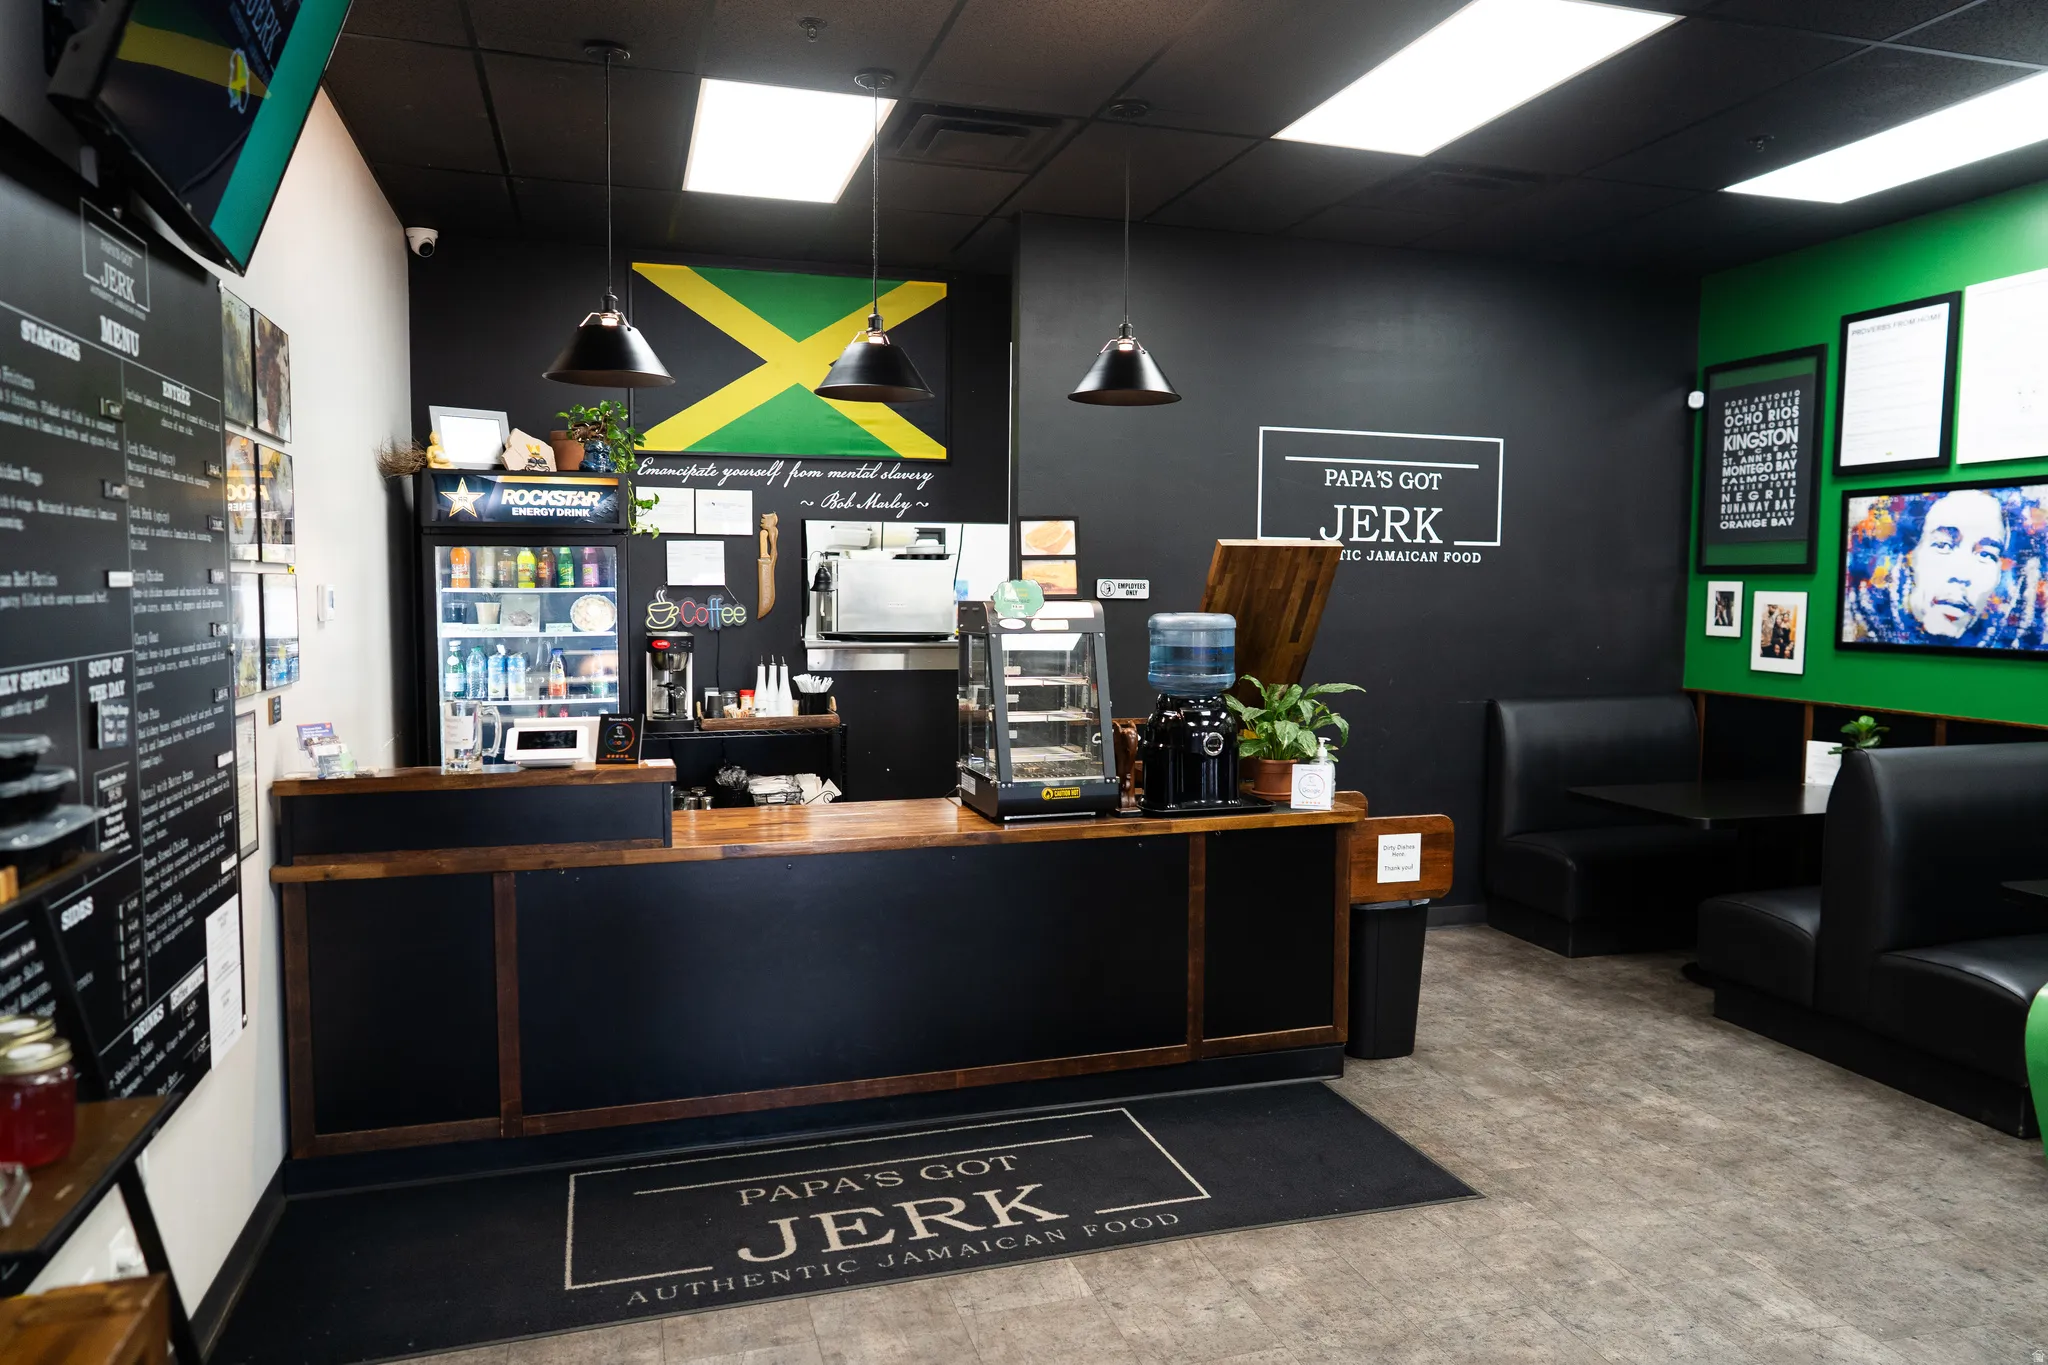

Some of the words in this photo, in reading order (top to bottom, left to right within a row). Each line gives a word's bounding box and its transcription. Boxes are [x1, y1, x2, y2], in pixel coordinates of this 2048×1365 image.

[100, 262, 136, 304] JERK
[100, 315, 140, 358] MENU
[1851, 323, 1891, 336] PROVERBS
[1893, 317, 1916, 328] FROM
[20, 319, 81, 362] STARTERS
[1724, 398, 1748, 408] PORT
[1754, 389, 1800, 404] ANTONIO
[1724, 397, 1800, 416] MANDEVILLE
[1724, 411, 1763, 428] OCHO
[1767, 405, 1800, 422] RIOS
[1724, 417, 1799, 435] WHITEHOUSE
[1723, 426, 1799, 452] KINGSTON
[1722, 457, 1736, 467] ST.
[1740, 453, 1772, 465] ANN'S
[1776, 450, 1798, 461] BAY
[1722, 461, 1773, 477] MONTEGO
[1775, 459, 1798, 472] BAY
[637, 456, 719, 485] Emancipate
[719, 460, 784, 487] yourself
[785, 460, 823, 488] from
[828, 462, 879, 480] mental
[880, 462, 935, 491] slavery
[1324, 468, 1393, 489] PAPA'S
[1399, 471, 1442, 491] GOT
[1721, 471, 1797, 486] FALMOUTH
[501, 489, 602, 507] ROCKSTAR
[821, 490, 854, 510] Bob
[857, 491, 913, 518] Marley
[1720, 501, 1769, 515] RUNAWAY
[1774, 499, 1795, 511] BAY
[1721, 488, 1796, 503] NEGRIL
[512, 507, 556, 517] ENERGY
[557, 507, 591, 517] DRINK
[1720, 518, 1767, 530] ORANGE
[1770, 516, 1794, 527] BAY
[1319, 504, 1444, 544] JERK
[1366, 550, 1438, 563] JAMAICAN
[1443, 551, 1482, 564] FOOD
[681, 597, 747, 628] Coffee
[88, 658, 111, 679] SOUP
[112, 656, 125, 674] OF
[0, 673, 19, 697] ILY
[20, 665, 70, 692] SPECIALS
[88, 682, 108, 703] THE
[108, 679, 126, 699] DAY
[61, 895, 94, 932] SIDES
[132, 1002, 165, 1045] DRINKS
[739, 1168, 905, 1207] PAPA'S
[919, 1153, 1019, 1182] GOT
[736, 1182, 1070, 1264] JERK
[626, 1258, 861, 1306] AUTHENTIC
[878, 1227, 1068, 1269] JAMAICAN
[1082, 1212, 1181, 1238] FOOD
